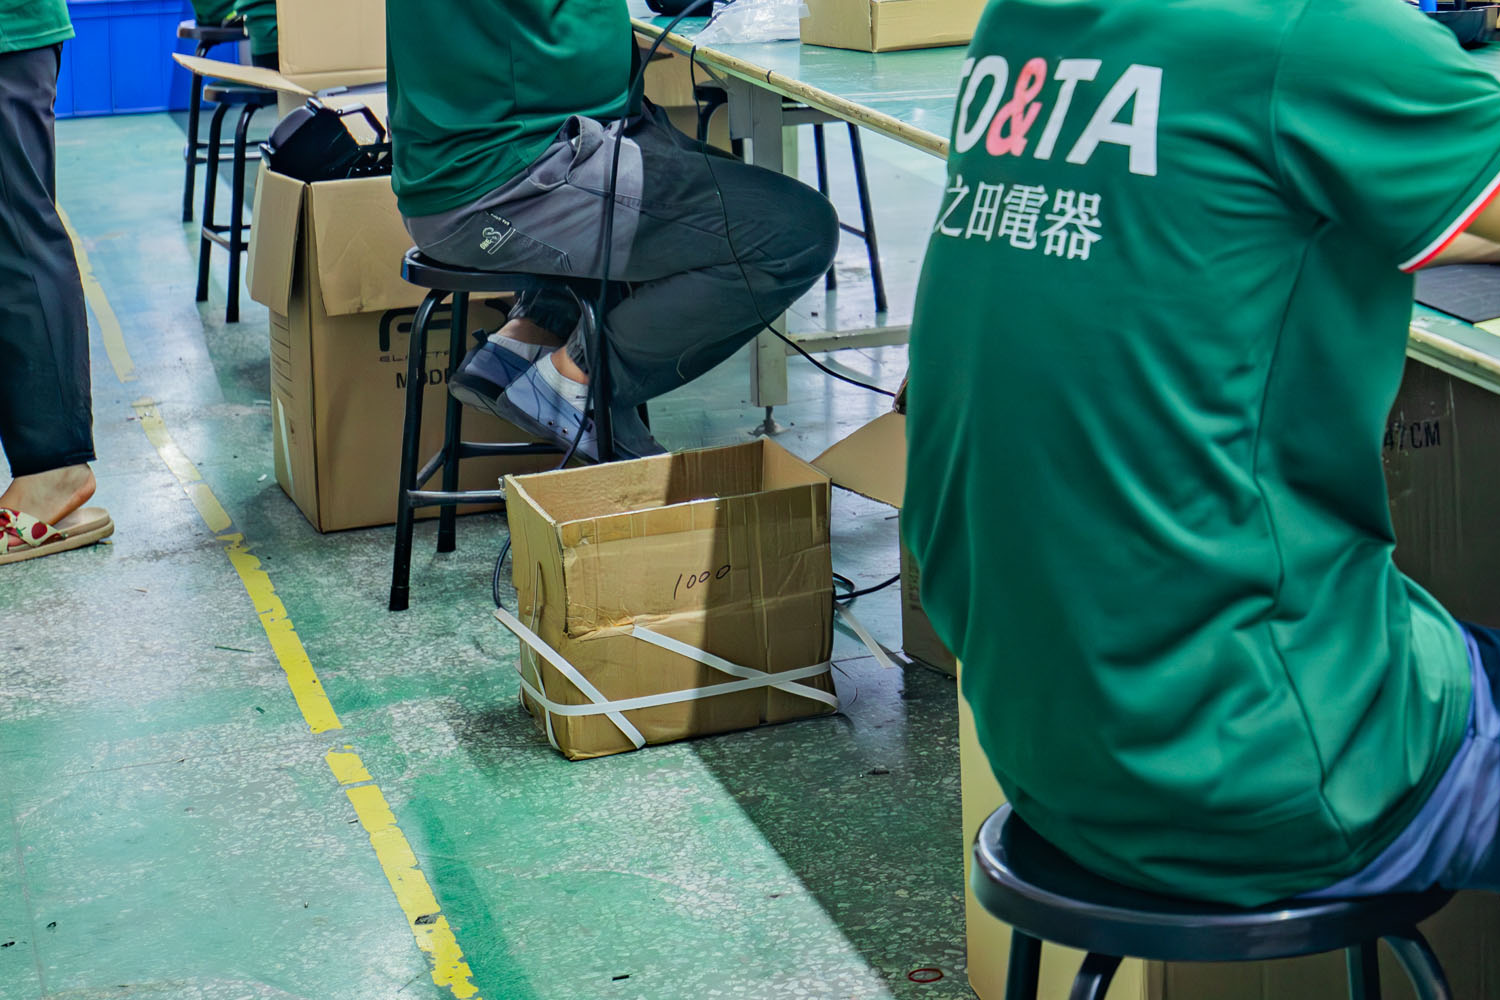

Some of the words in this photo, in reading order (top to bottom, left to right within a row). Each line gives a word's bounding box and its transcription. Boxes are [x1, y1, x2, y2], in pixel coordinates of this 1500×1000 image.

[934, 173, 1103, 261] 之田電器
[673, 564, 731, 601] 1000
